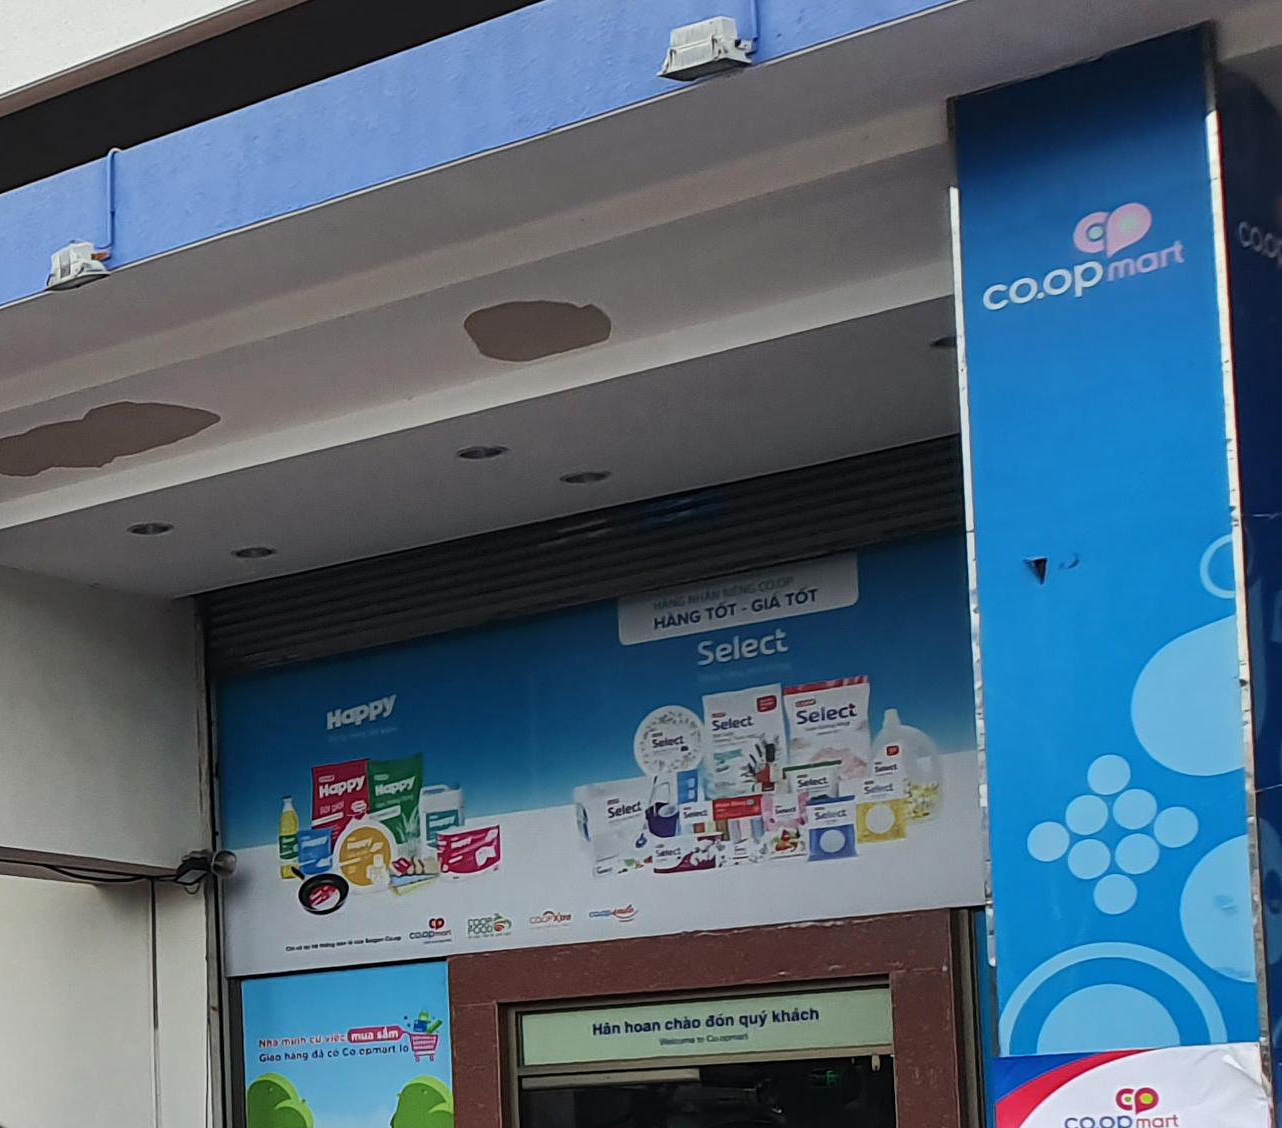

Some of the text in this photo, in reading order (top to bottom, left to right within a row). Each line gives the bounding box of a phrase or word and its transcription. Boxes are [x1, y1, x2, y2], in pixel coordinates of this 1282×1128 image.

[653, 588, 818, 630] HÀNG TỐT GIÁ TỐT
[697, 628, 789, 666] Select
[326, 694, 396, 730] Happy
[795, 703, 858, 725] Select
[711, 715, 755, 731] Select
[651, 735, 685, 749] Select
[318, 775, 366, 799] Happy
[374, 775, 416, 797] Happy
[797, 775, 829, 788] Select
[607, 801, 642, 818] Select
[814, 808, 848, 821] Select
[592, 1007, 819, 1036] Hân hoan chào đón quý khách
[350, 1026, 399, 1042] mua sắm
[259, 1052, 281, 1063] Giao
